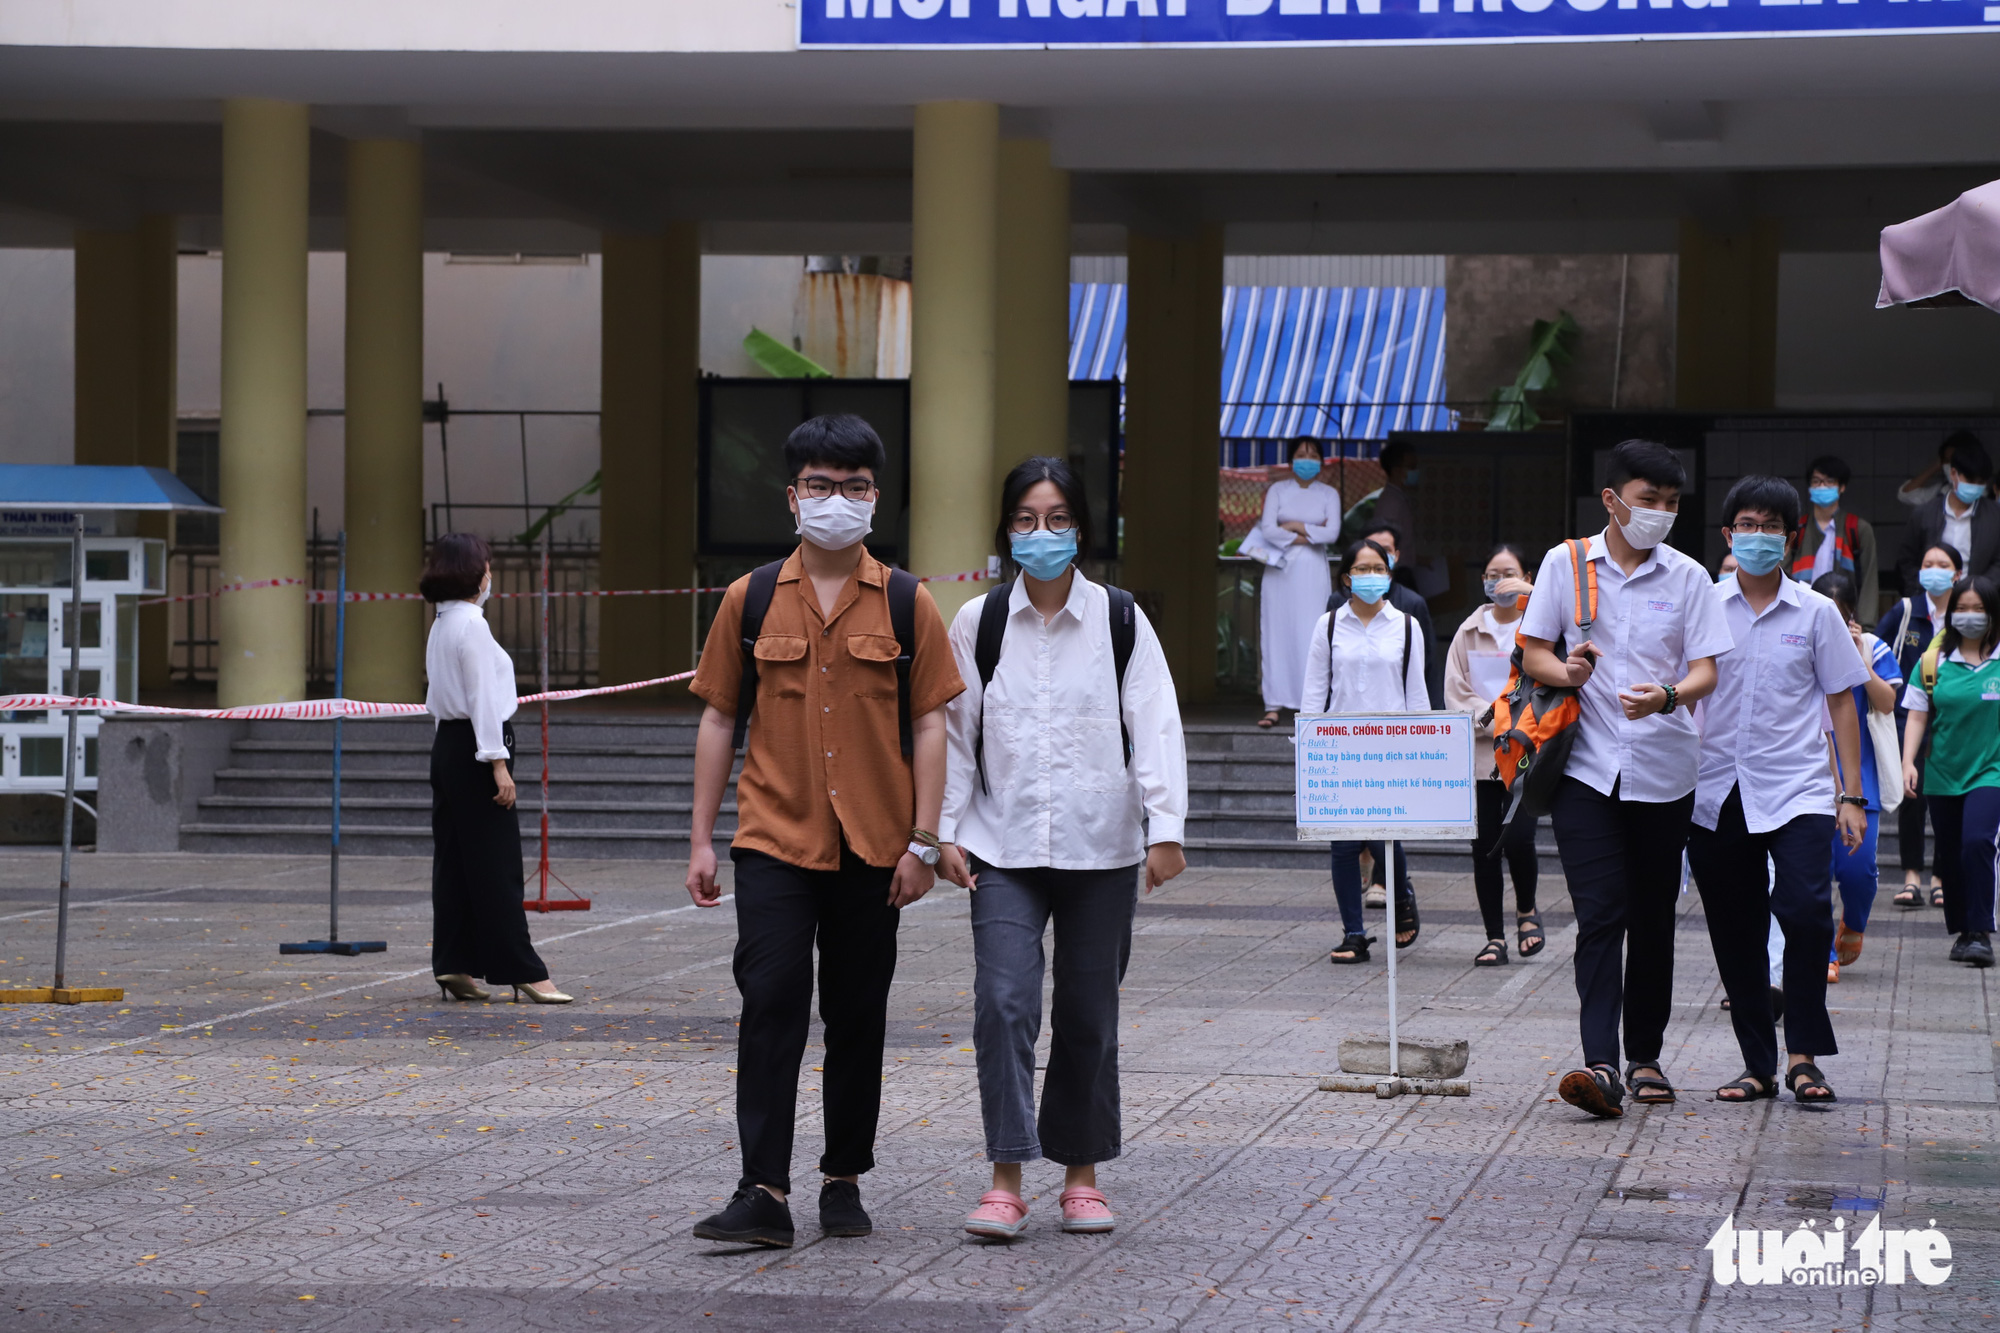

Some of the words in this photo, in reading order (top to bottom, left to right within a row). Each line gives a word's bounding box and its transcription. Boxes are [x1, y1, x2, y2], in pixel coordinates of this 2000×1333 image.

[1316, 723, 1350, 737] PHÒNG,
[1352, 722, 1384, 736] CHỐNG
[1386, 725, 1407, 737] DỊCH
[1410, 725, 1451, 735] COVID-19
[1326, 753, 1338, 762] tay
[1363, 752, 1383, 762] dung
[1385, 752, 1403, 762] dịch
[1405, 751, 1418, 760] sát
[1308, 780, 1319, 788] Đo
[1321, 779, 1340, 788] thân
[1342, 779, 1362, 789] nhiệt
[1387, 779, 1408, 789] nhiệt
[1410, 777, 1420, 788] kế
[1309, 806, 1317, 815] Di
[1350, 806, 1365, 815] vào
[1367, 806, 1392, 817] phòng
[1394, 806, 1408, 815] thi.
